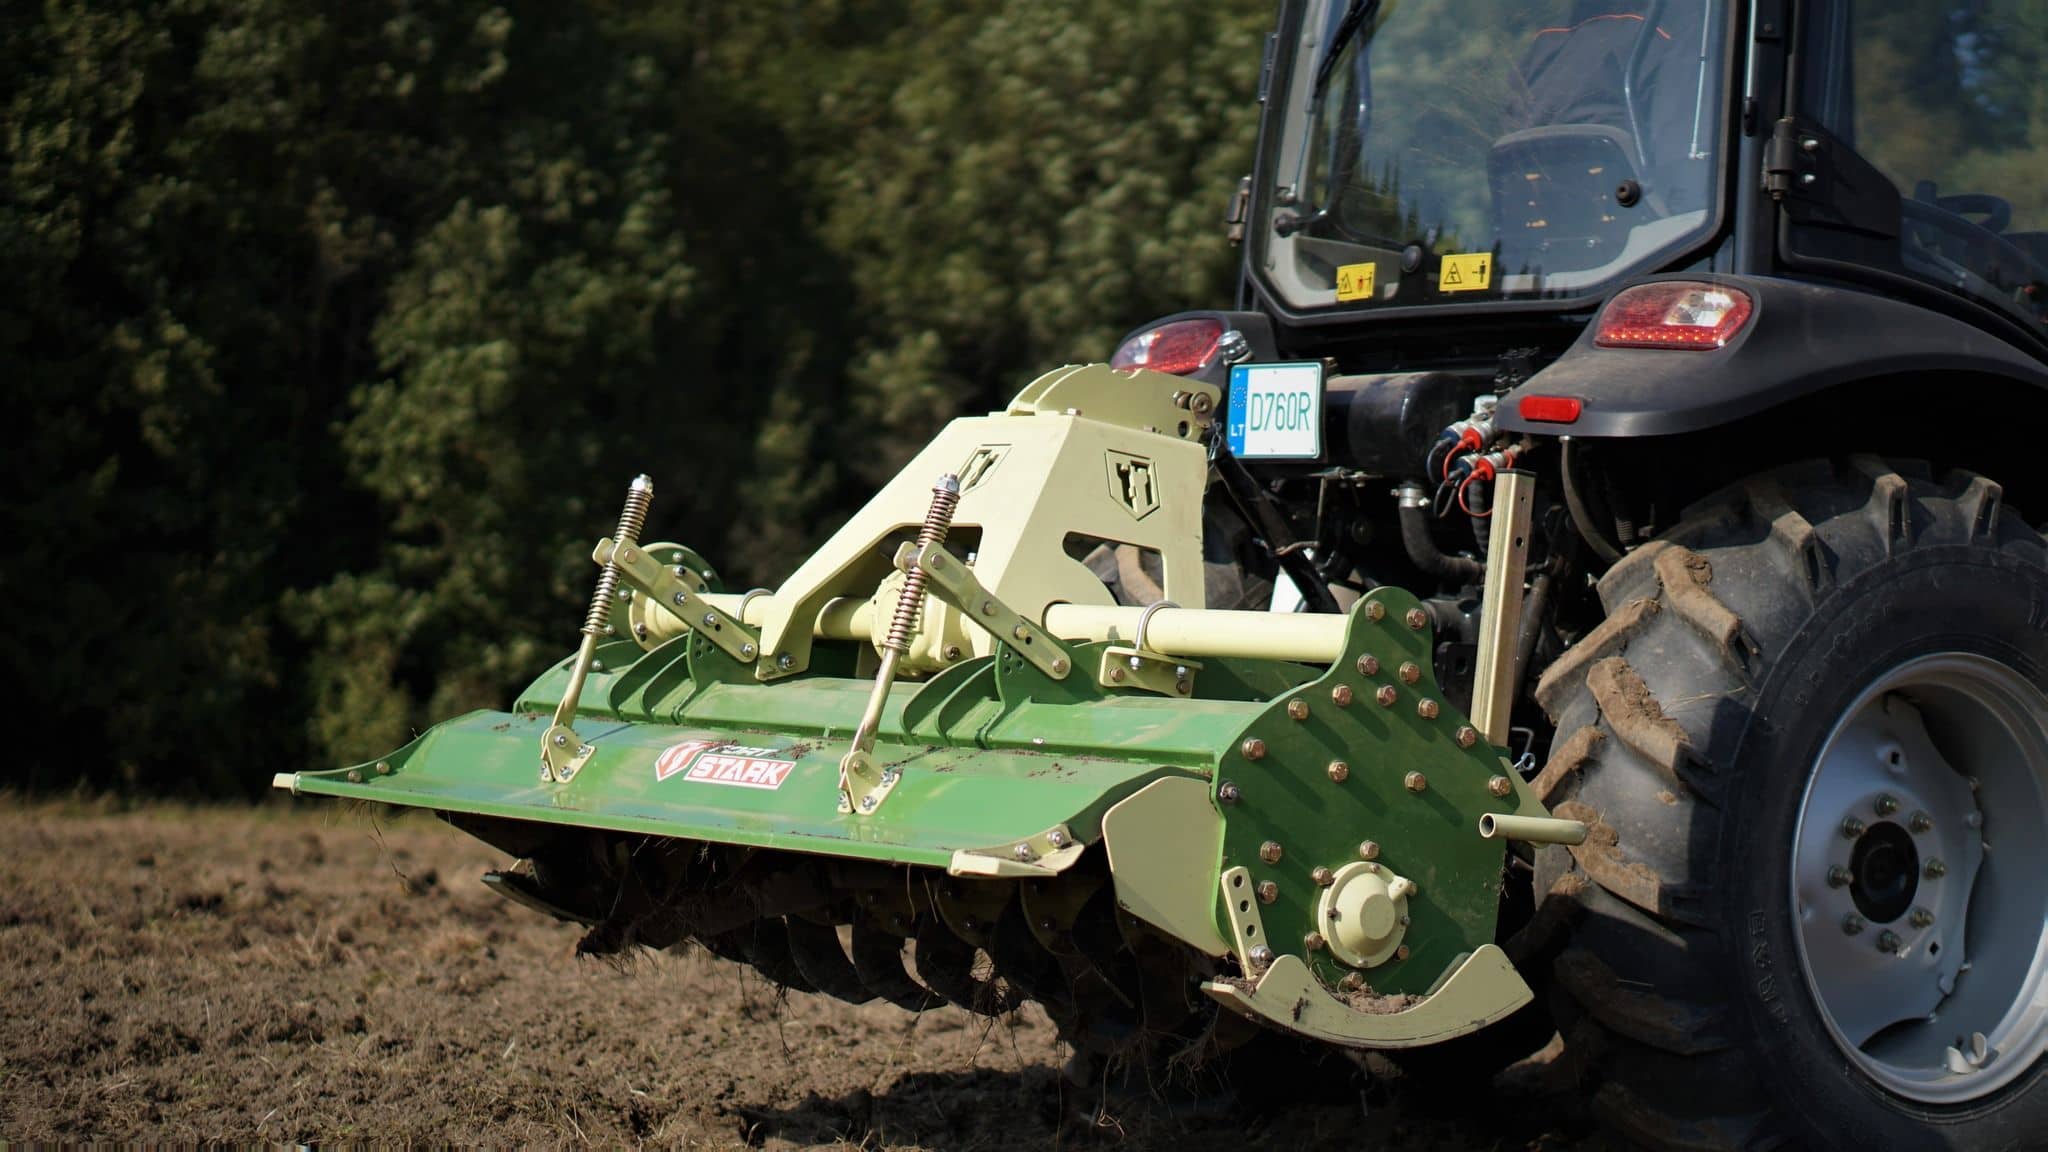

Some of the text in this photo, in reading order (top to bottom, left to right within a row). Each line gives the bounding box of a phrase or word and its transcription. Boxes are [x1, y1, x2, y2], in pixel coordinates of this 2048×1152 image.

[1250, 392, 1311, 431] D760R
[1231, 424, 1245, 437] LT
[691, 756, 791, 785] STARK
